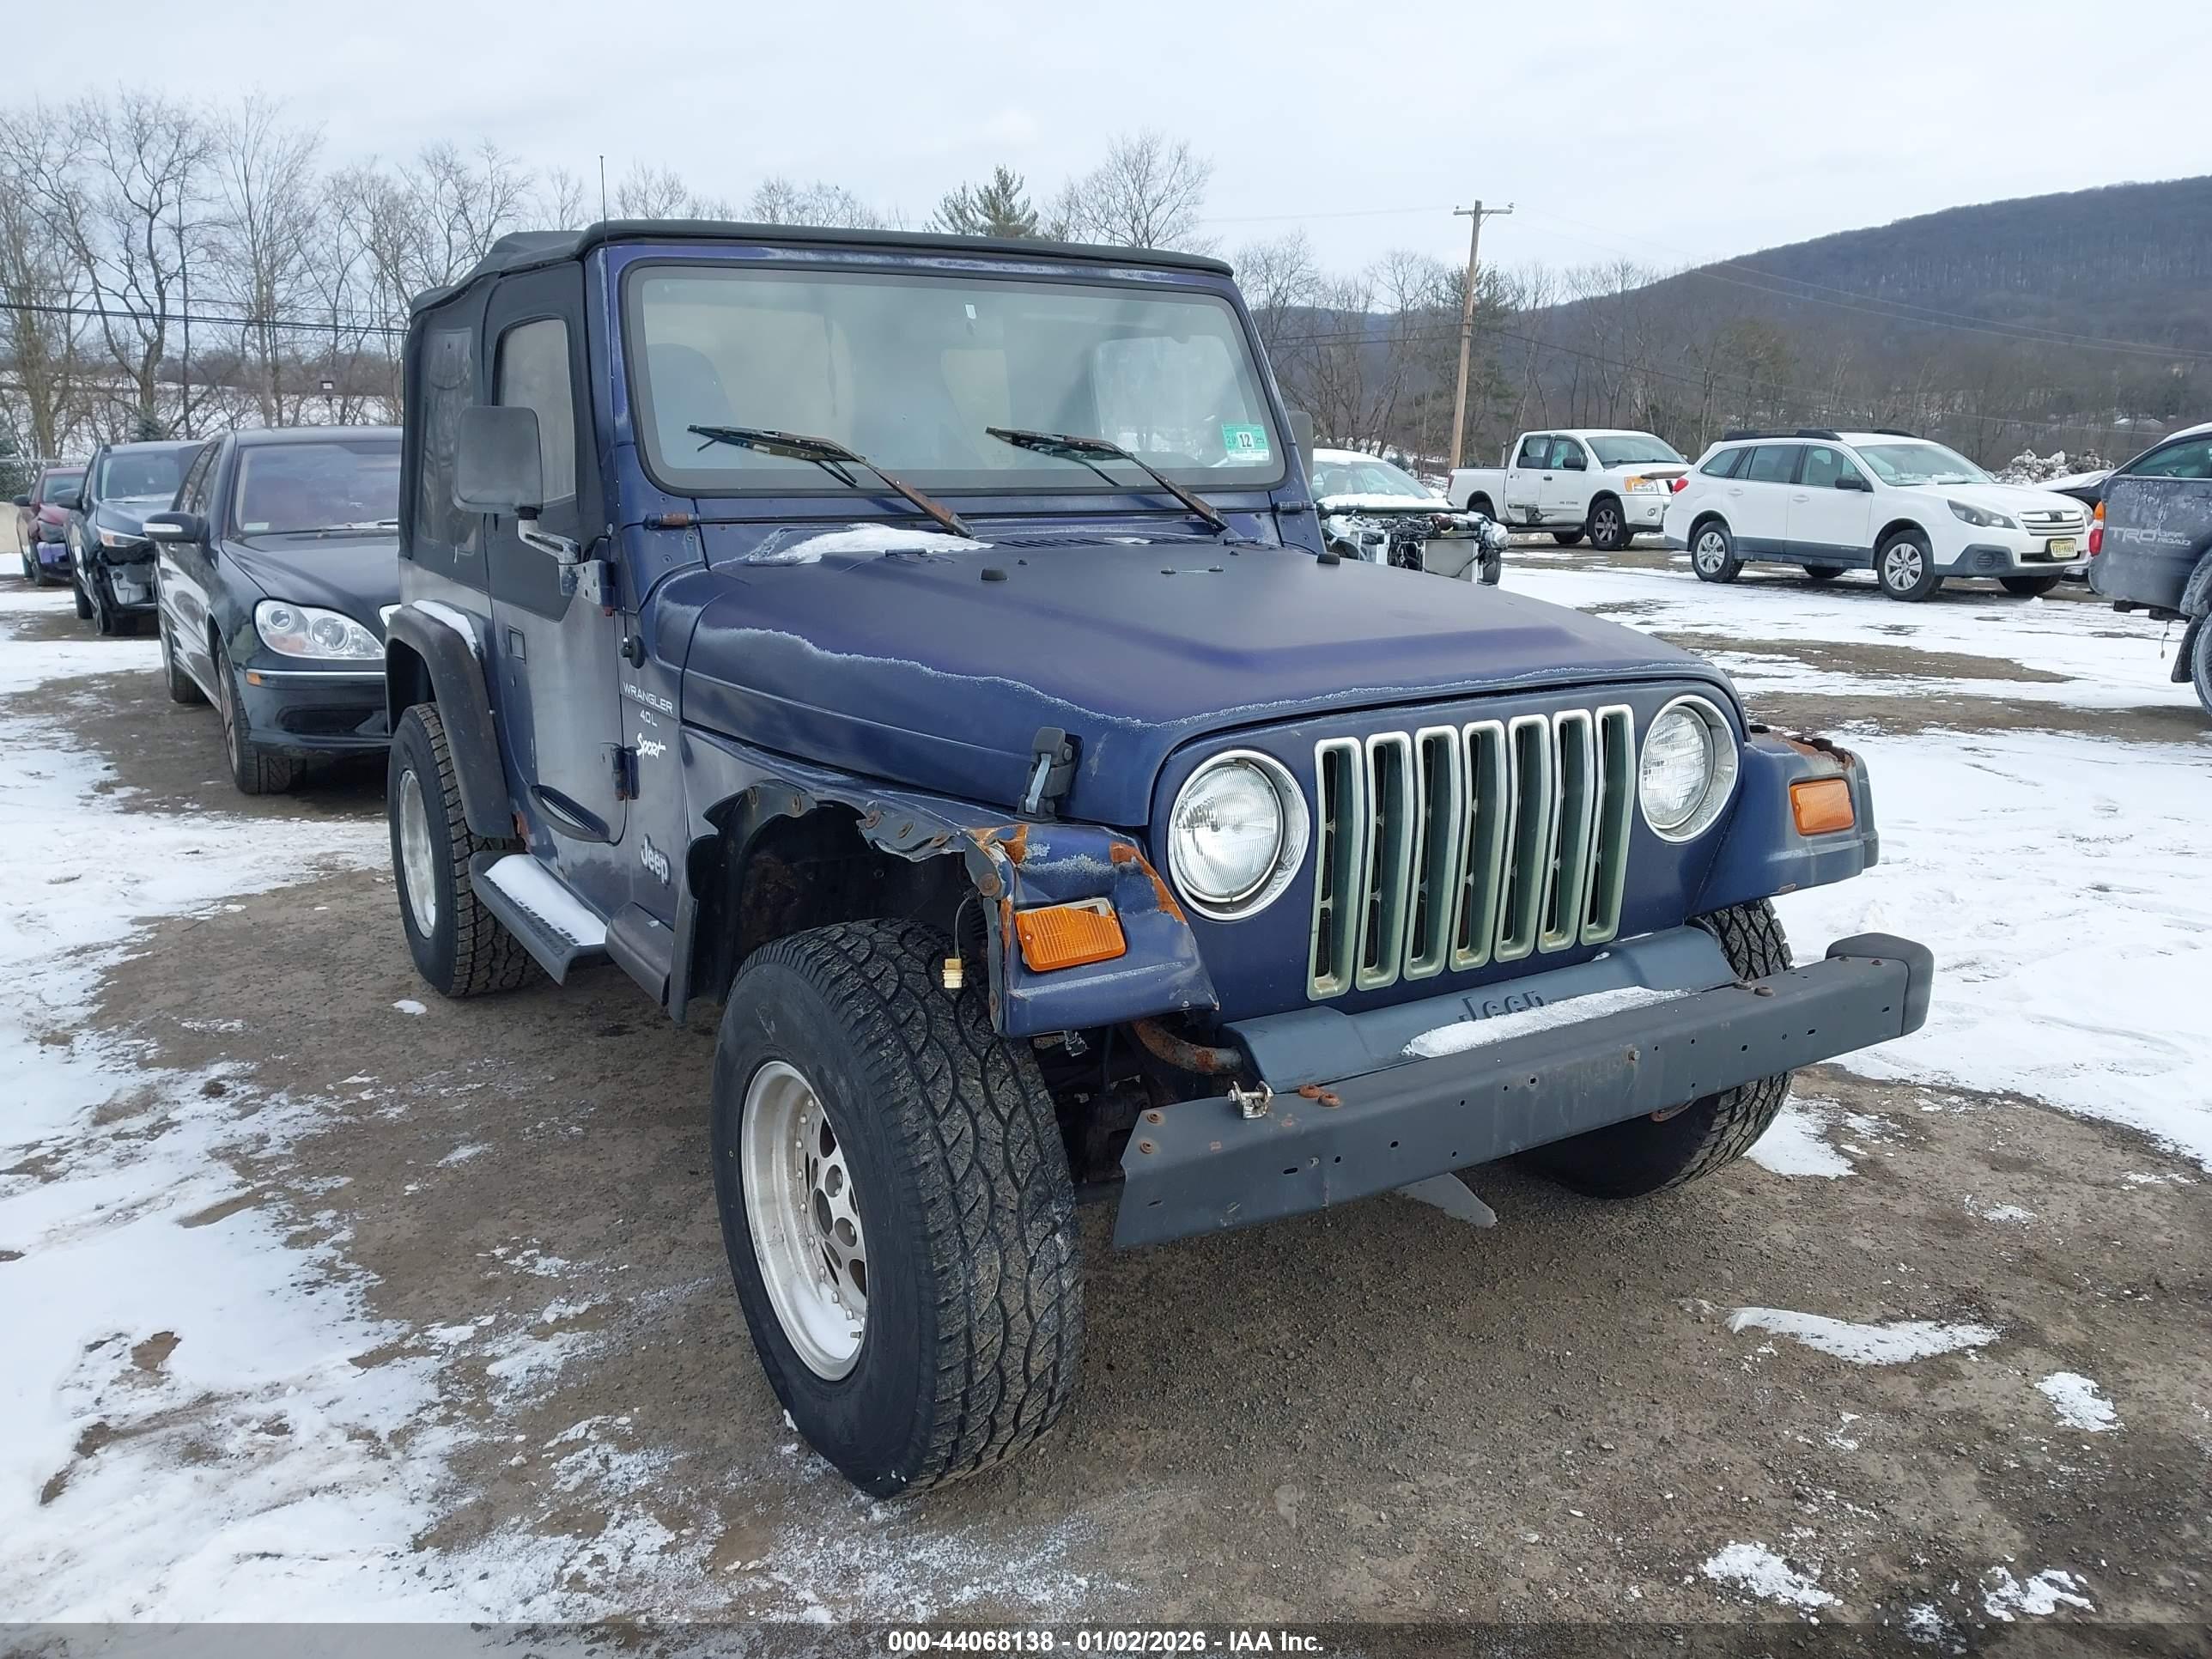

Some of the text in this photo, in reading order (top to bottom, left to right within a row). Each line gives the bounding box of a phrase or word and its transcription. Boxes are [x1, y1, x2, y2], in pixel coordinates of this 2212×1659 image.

[1239, 434, 1253, 447] 12
[623, 681, 673, 714] WRANGLER
[641, 834, 670, 886] Jeep
